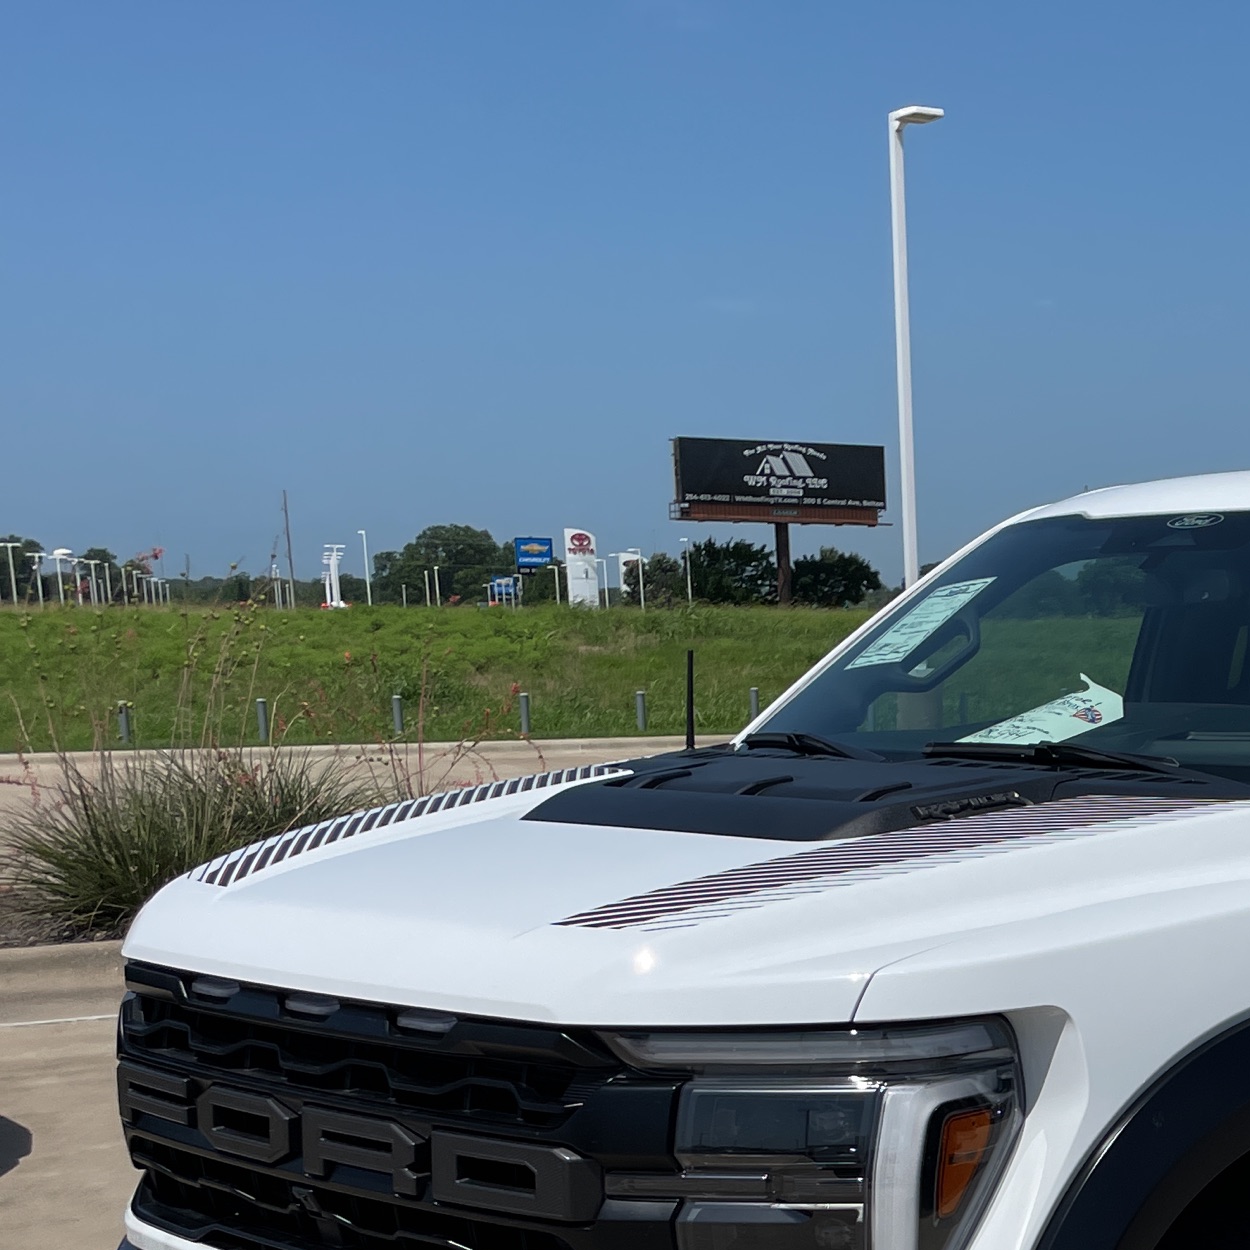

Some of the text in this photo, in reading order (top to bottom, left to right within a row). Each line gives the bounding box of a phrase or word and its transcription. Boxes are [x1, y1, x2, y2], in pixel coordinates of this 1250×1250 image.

[782, 443, 806, 453] Roofing
[768, 475, 806, 488] Roofing
[806, 477, 827, 488] LLC
[1173, 514, 1218, 527] Ford
[567, 547, 595, 556] TOYOTA
[118, 1060, 603, 1222] FORD
